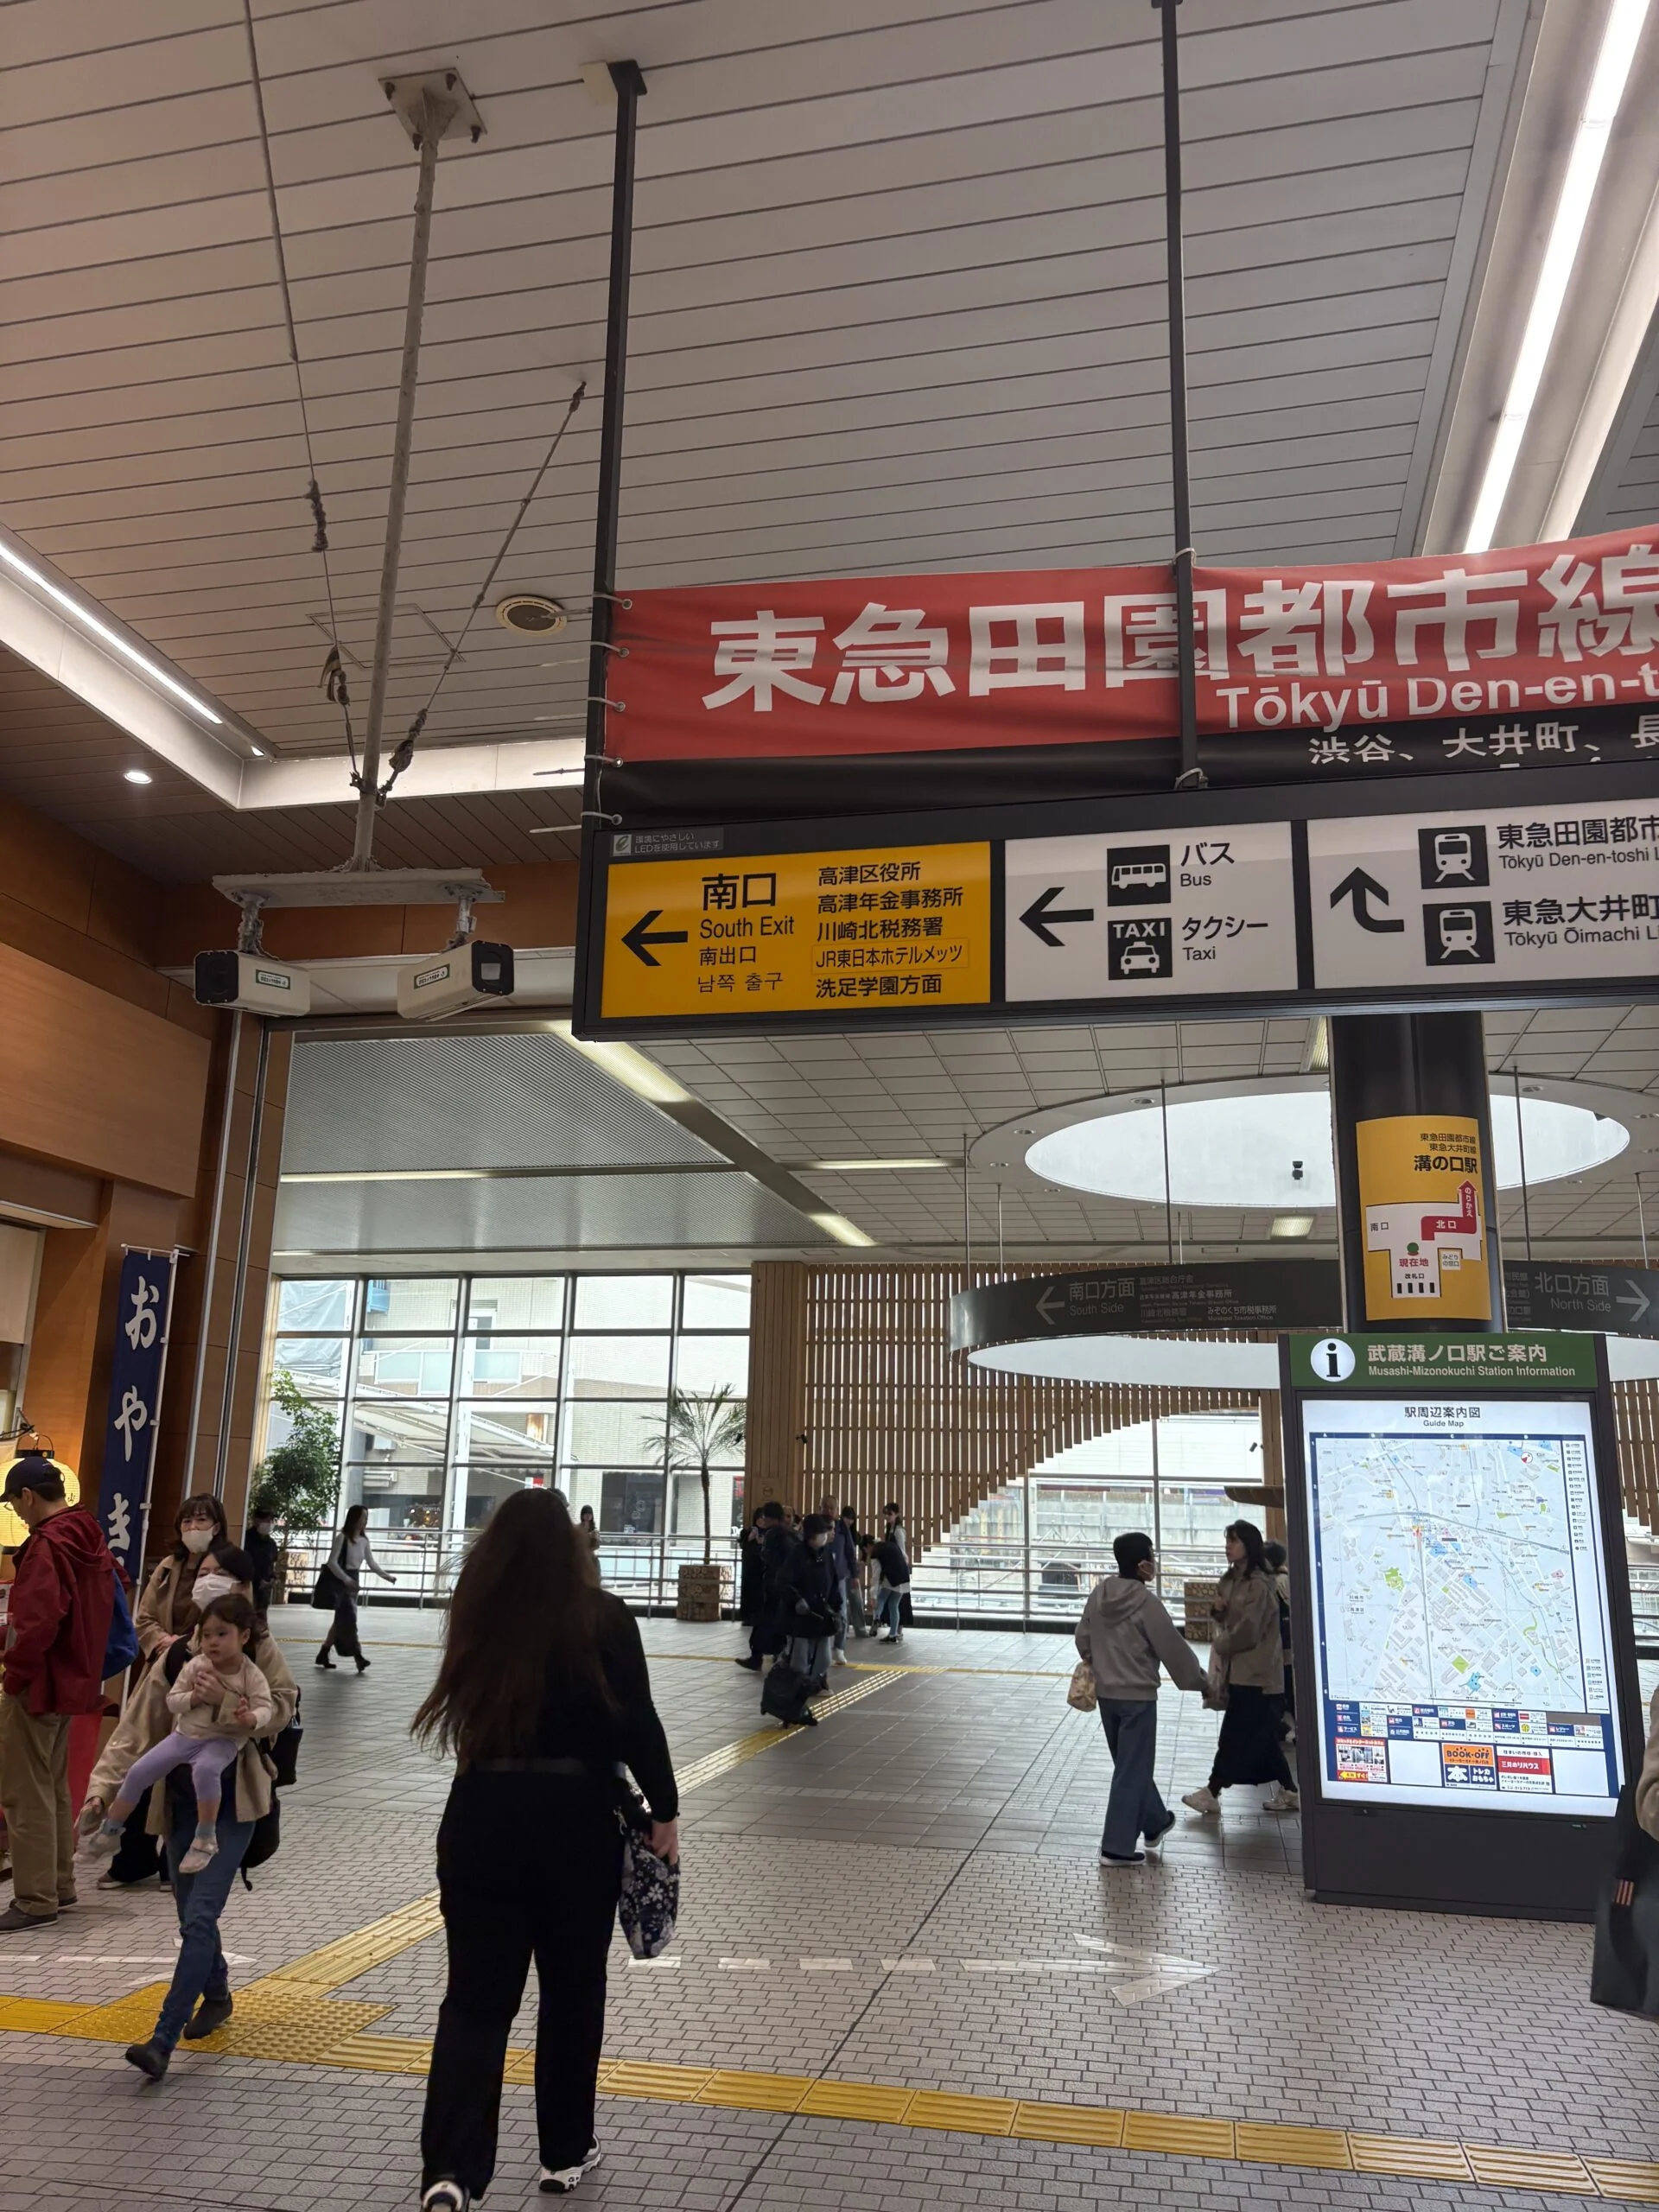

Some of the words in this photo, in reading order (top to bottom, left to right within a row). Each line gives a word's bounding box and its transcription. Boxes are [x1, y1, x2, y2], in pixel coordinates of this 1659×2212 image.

[702, 543, 1659, 712] 東急田園都市線
[1216, 679, 1389, 733] Tōkyū
[1180, 842, 1236, 868] バス
[1498, 854, 1544, 872] Tōkyū
[1548, 847, 1649, 867] Den-en-toshi
[817, 861, 921, 887] 高津区役所
[1179, 872, 1212, 887] Bus
[701, 872, 778, 912] 南口
[817, 887, 963, 914] 高津年金事務所
[1502, 893, 1659, 926] 東急大井町
[700, 916, 753, 940] South
[760, 914, 795, 937] Exit
[816, 917, 944, 942] 川崎北税務署
[1112, 921, 1166, 939] TAXI
[1181, 916, 1269, 942] タクシー
[1503, 931, 1558, 949] Tōkyū
[1563, 925, 1640, 944] Ōimachi
[698, 945, 758, 968] 南出口
[815, 943, 963, 970] JR東日本ホテルメッツ
[1182, 945, 1217, 962] Taxi
[696, 975, 734, 994] 남쪽
[744, 971, 784, 992] 출구
[815, 973, 943, 999] 洗足学園方面
[1420, 1133, 1476, 1145] 東急田園都市線
[1429, 1142, 1477, 1154] 東急大井町線
[1414, 1154, 1478, 1174] 溝の口駅
[1464, 1186, 1473, 1218] のりかえ
[1370, 1221, 1389, 1232] 南口
[1435, 1219, 1457, 1230] 北口
[1398, 1257, 1430, 1268] 現在地
[1069, 1277, 1135, 1301] 南口方面
[1534, 1271, 1610, 1297] 北口方面
[1069, 1304, 1098, 1317] South
[1102, 1302, 1124, 1314] Side
[1550, 1297, 1584, 1311] North
[1586, 1299, 1611, 1313] Side
[1367, 1344, 1548, 1363] 武蔵溝ノ口駅ご案内
[1368, 1365, 1476, 1376] Musashi-Mizonokuchi
[1478, 1365, 1514, 1376] Station
[1516, 1365, 1576, 1376] Information
[107, 1275, 160, 1567] おやき
[1404, 1406, 1481, 1419] 駅周辺案内図
[1447, 1420, 1465, 1428] Map
[1446, 1765, 1468, 1783] 本
[1501, 1761, 1540, 1770] 三井のリハウス
